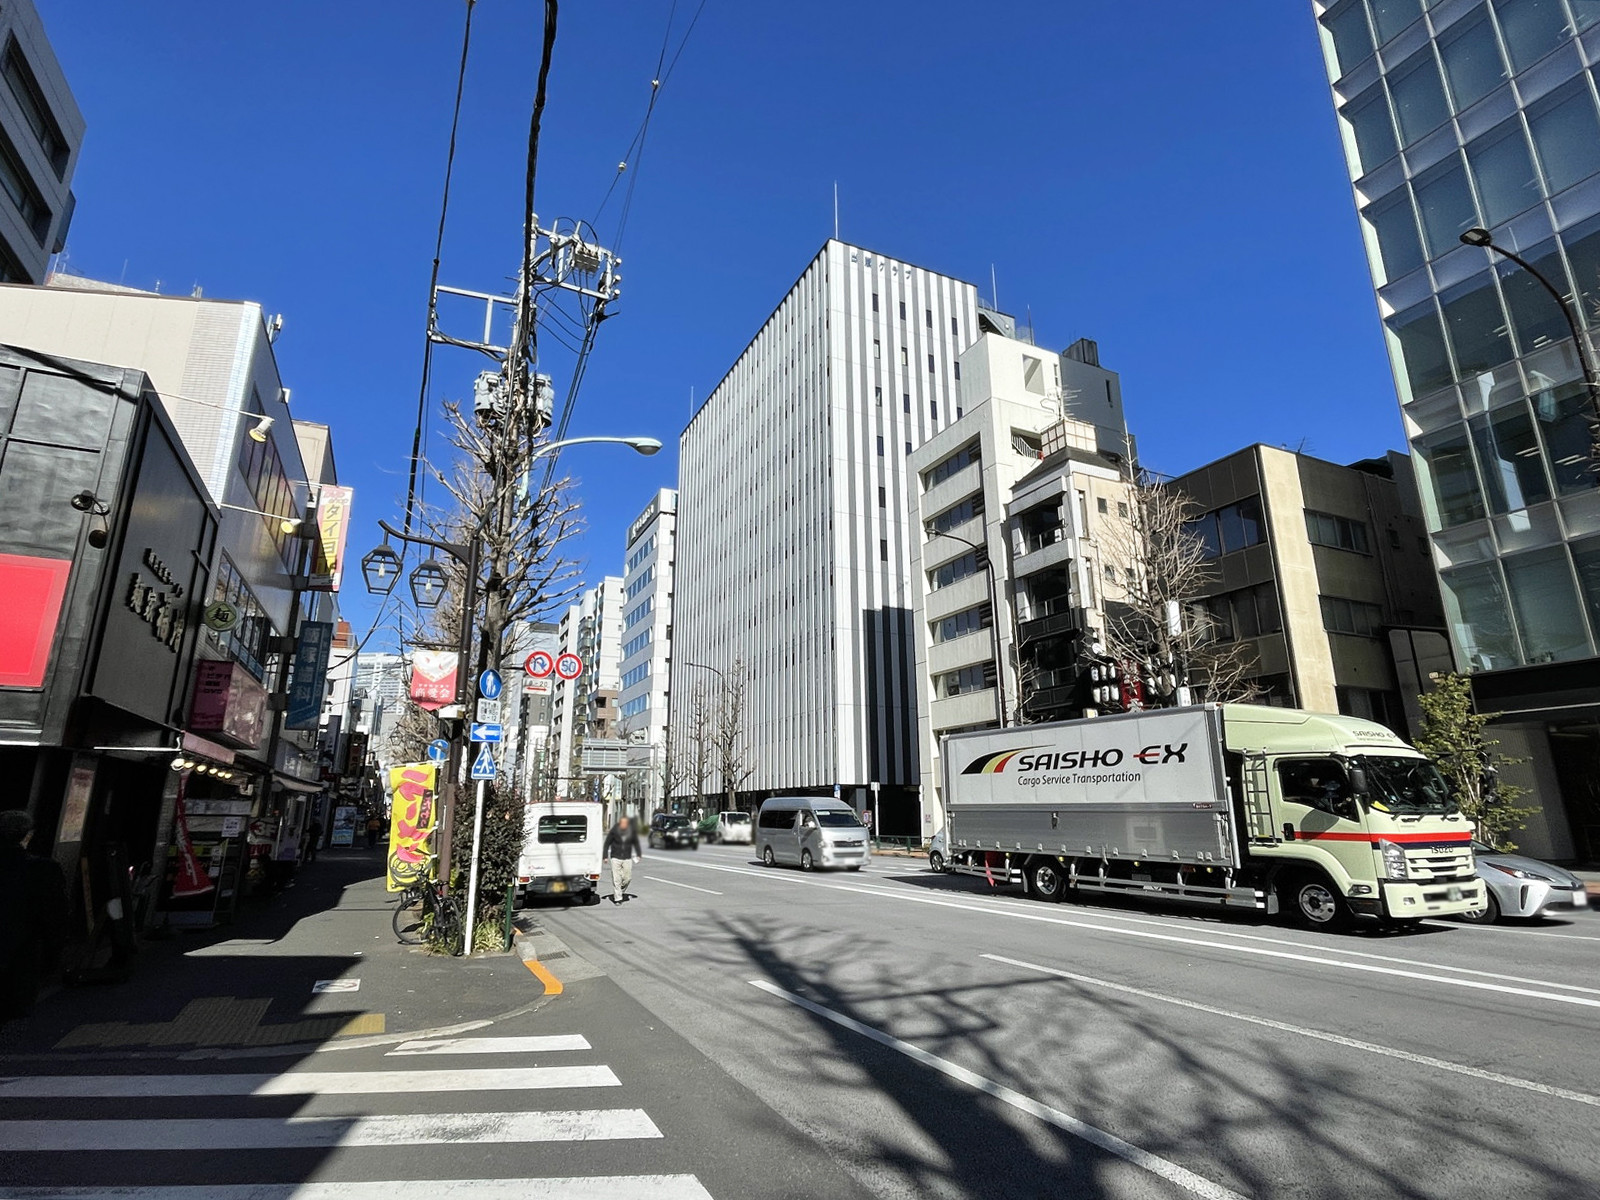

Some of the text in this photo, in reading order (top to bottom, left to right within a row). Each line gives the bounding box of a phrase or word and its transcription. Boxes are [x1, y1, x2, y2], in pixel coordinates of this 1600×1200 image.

[210, 607, 230, 622] 麺
[561, 660, 576, 673] 50
[1018, 743, 1188, 772] SAISHO EX
[1018, 771, 1141, 788] Cargo Service Transportation
[1430, 845, 1454, 854] ISUZU
